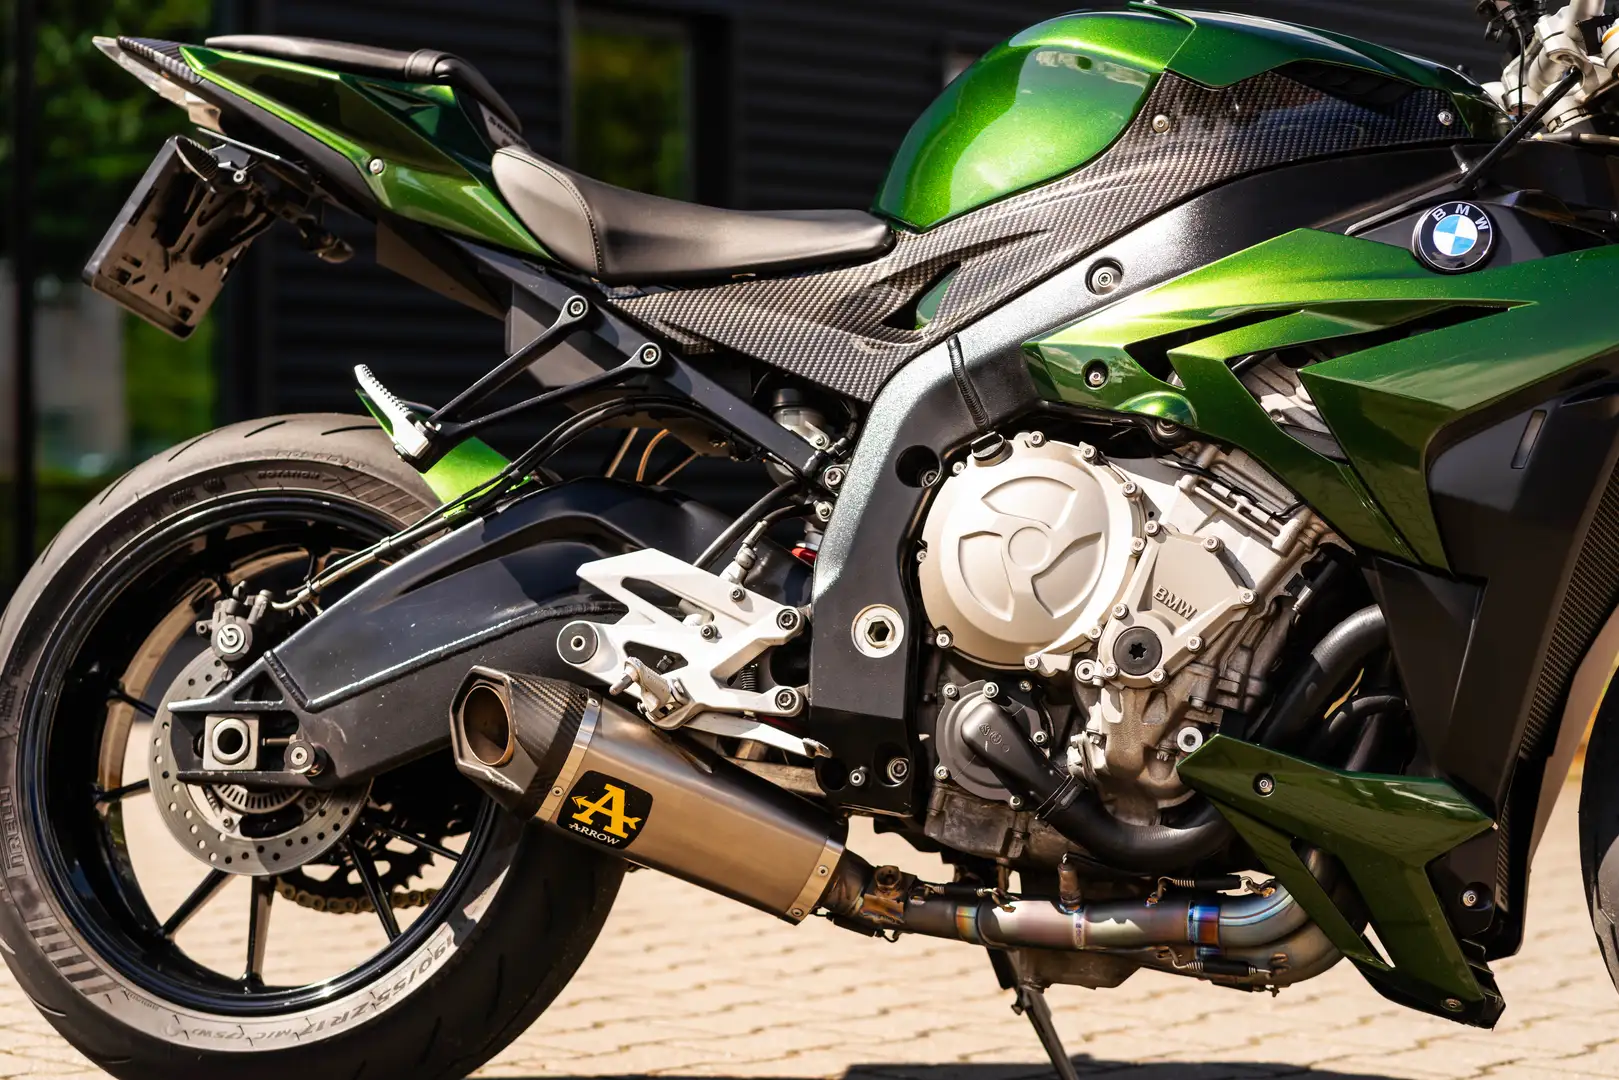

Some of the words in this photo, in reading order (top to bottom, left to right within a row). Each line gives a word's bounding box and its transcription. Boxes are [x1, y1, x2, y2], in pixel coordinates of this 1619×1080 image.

[1431, 203, 1489, 230] BMW
[257, 469, 320, 480] ROTATION
[1153, 585, 1197, 621] BMW
[0, 787, 27, 878] PIRELLI
[569, 823, 620, 845] ARROW
